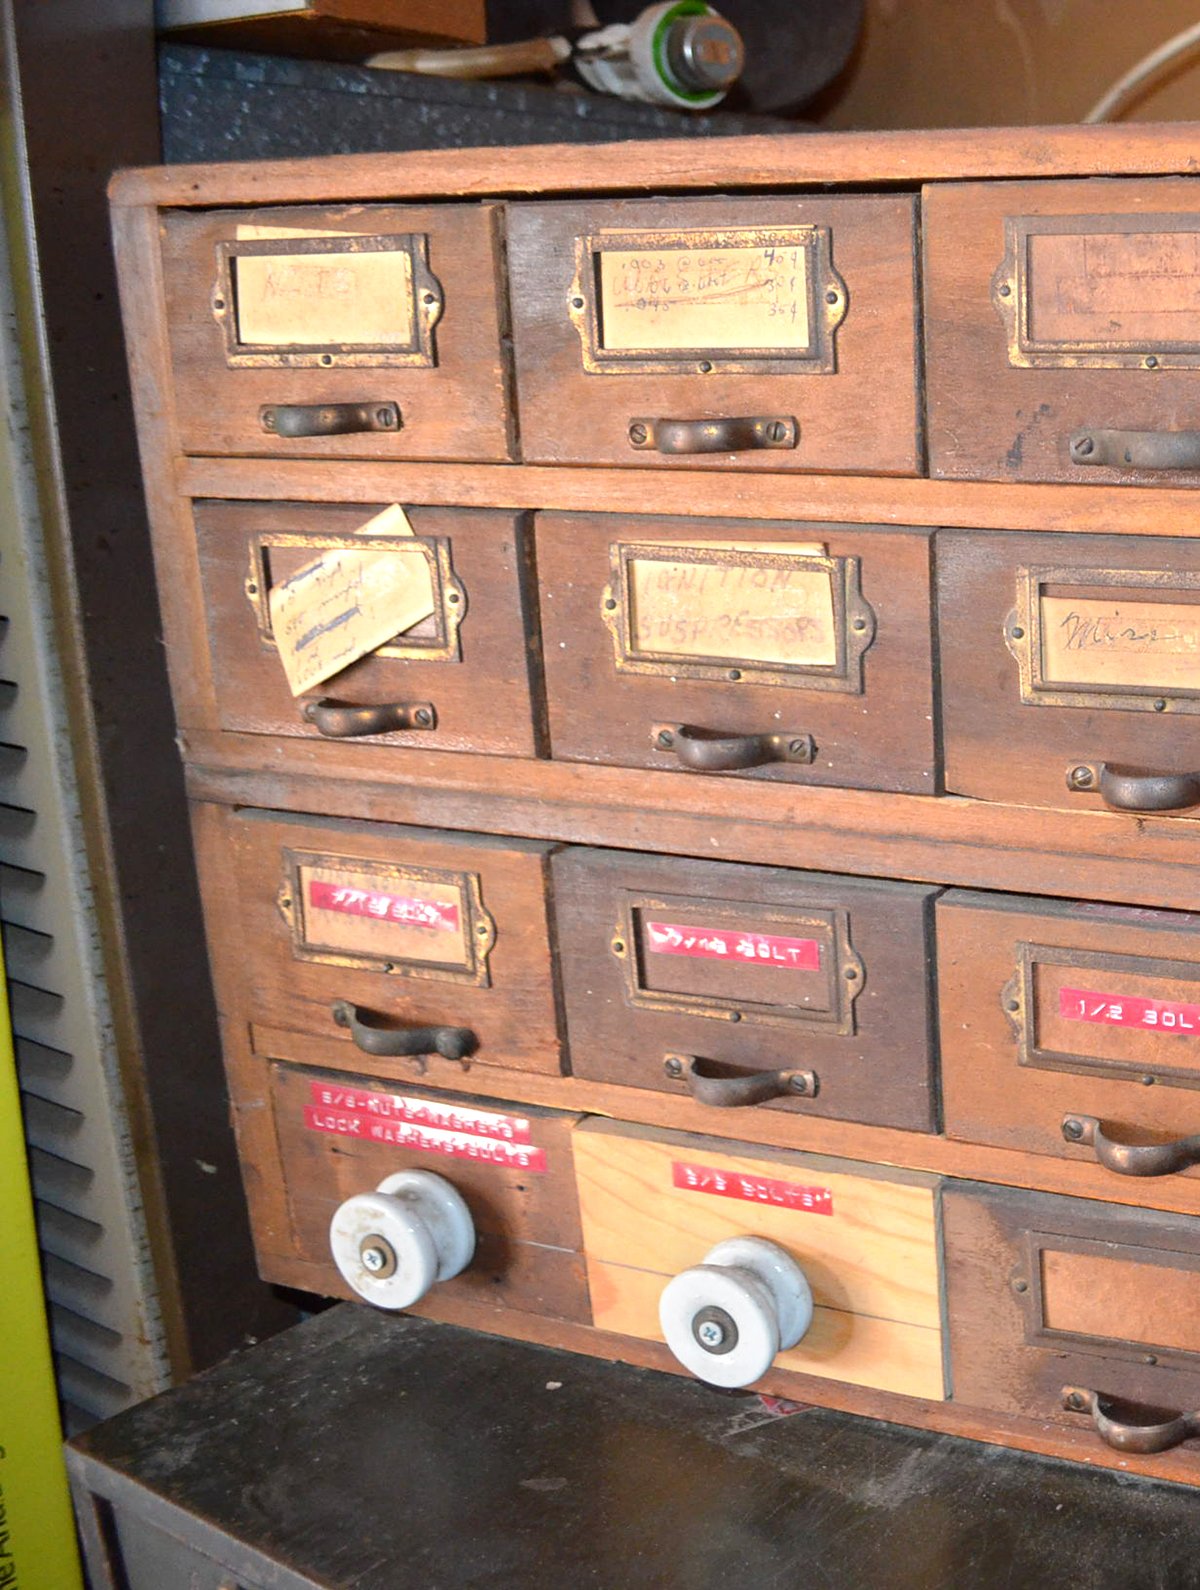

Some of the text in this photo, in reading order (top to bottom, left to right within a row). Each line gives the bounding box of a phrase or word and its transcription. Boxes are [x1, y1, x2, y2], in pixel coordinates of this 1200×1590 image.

[736, 938, 802, 964] BOLT
[1078, 1000, 1123, 1021] 1/2
[312, 1113, 362, 1135] LOCK
